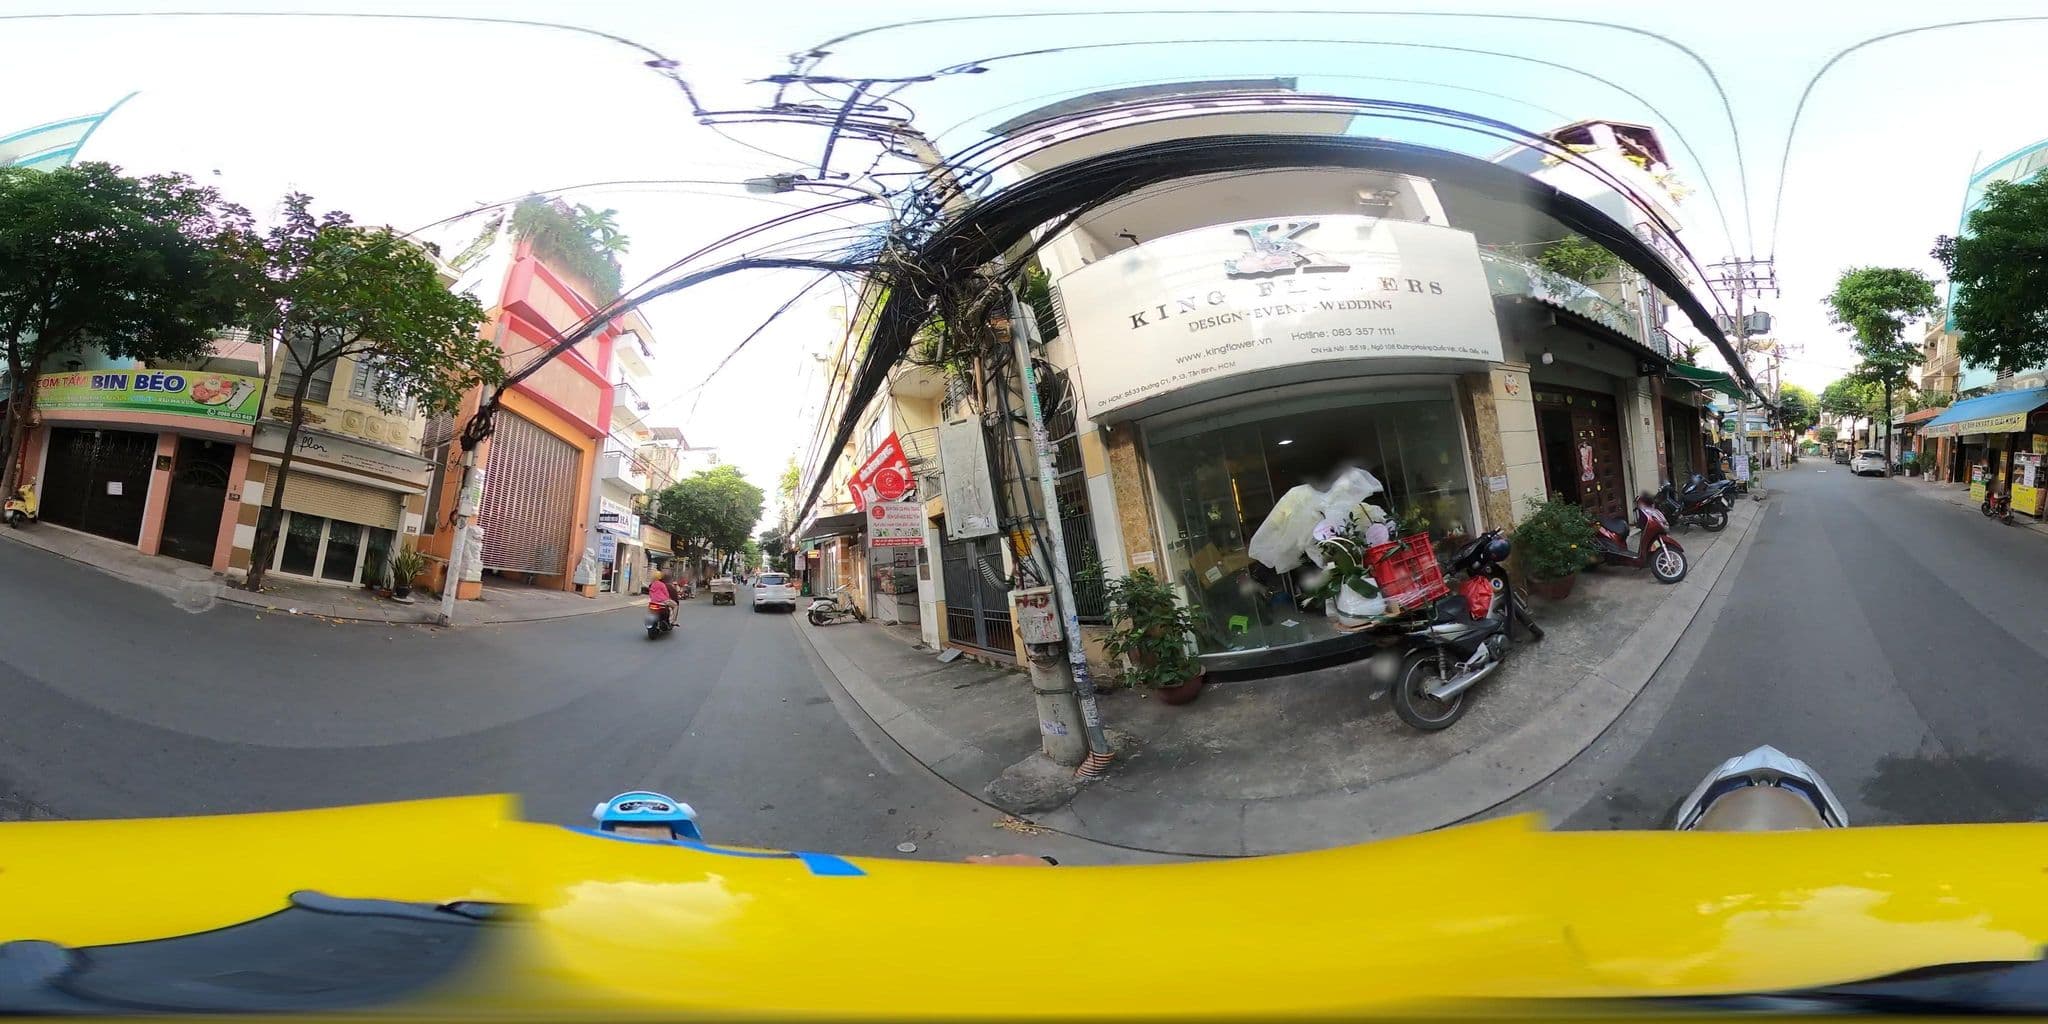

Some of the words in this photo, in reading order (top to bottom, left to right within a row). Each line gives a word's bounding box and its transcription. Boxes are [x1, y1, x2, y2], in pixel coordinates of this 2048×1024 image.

[1128, 290, 1227, 330] KING
[1188, 311, 1244, 333] DESIGN
[1254, 302, 1307, 320] EVEN
[1319, 299, 1393, 312] WEDDING
[1331, 327, 1352, 337] 083
[1355, 327, 1375, 336] 357
[1377, 327, 1396, 336] 1111
[91, 373, 130, 392] BIN
